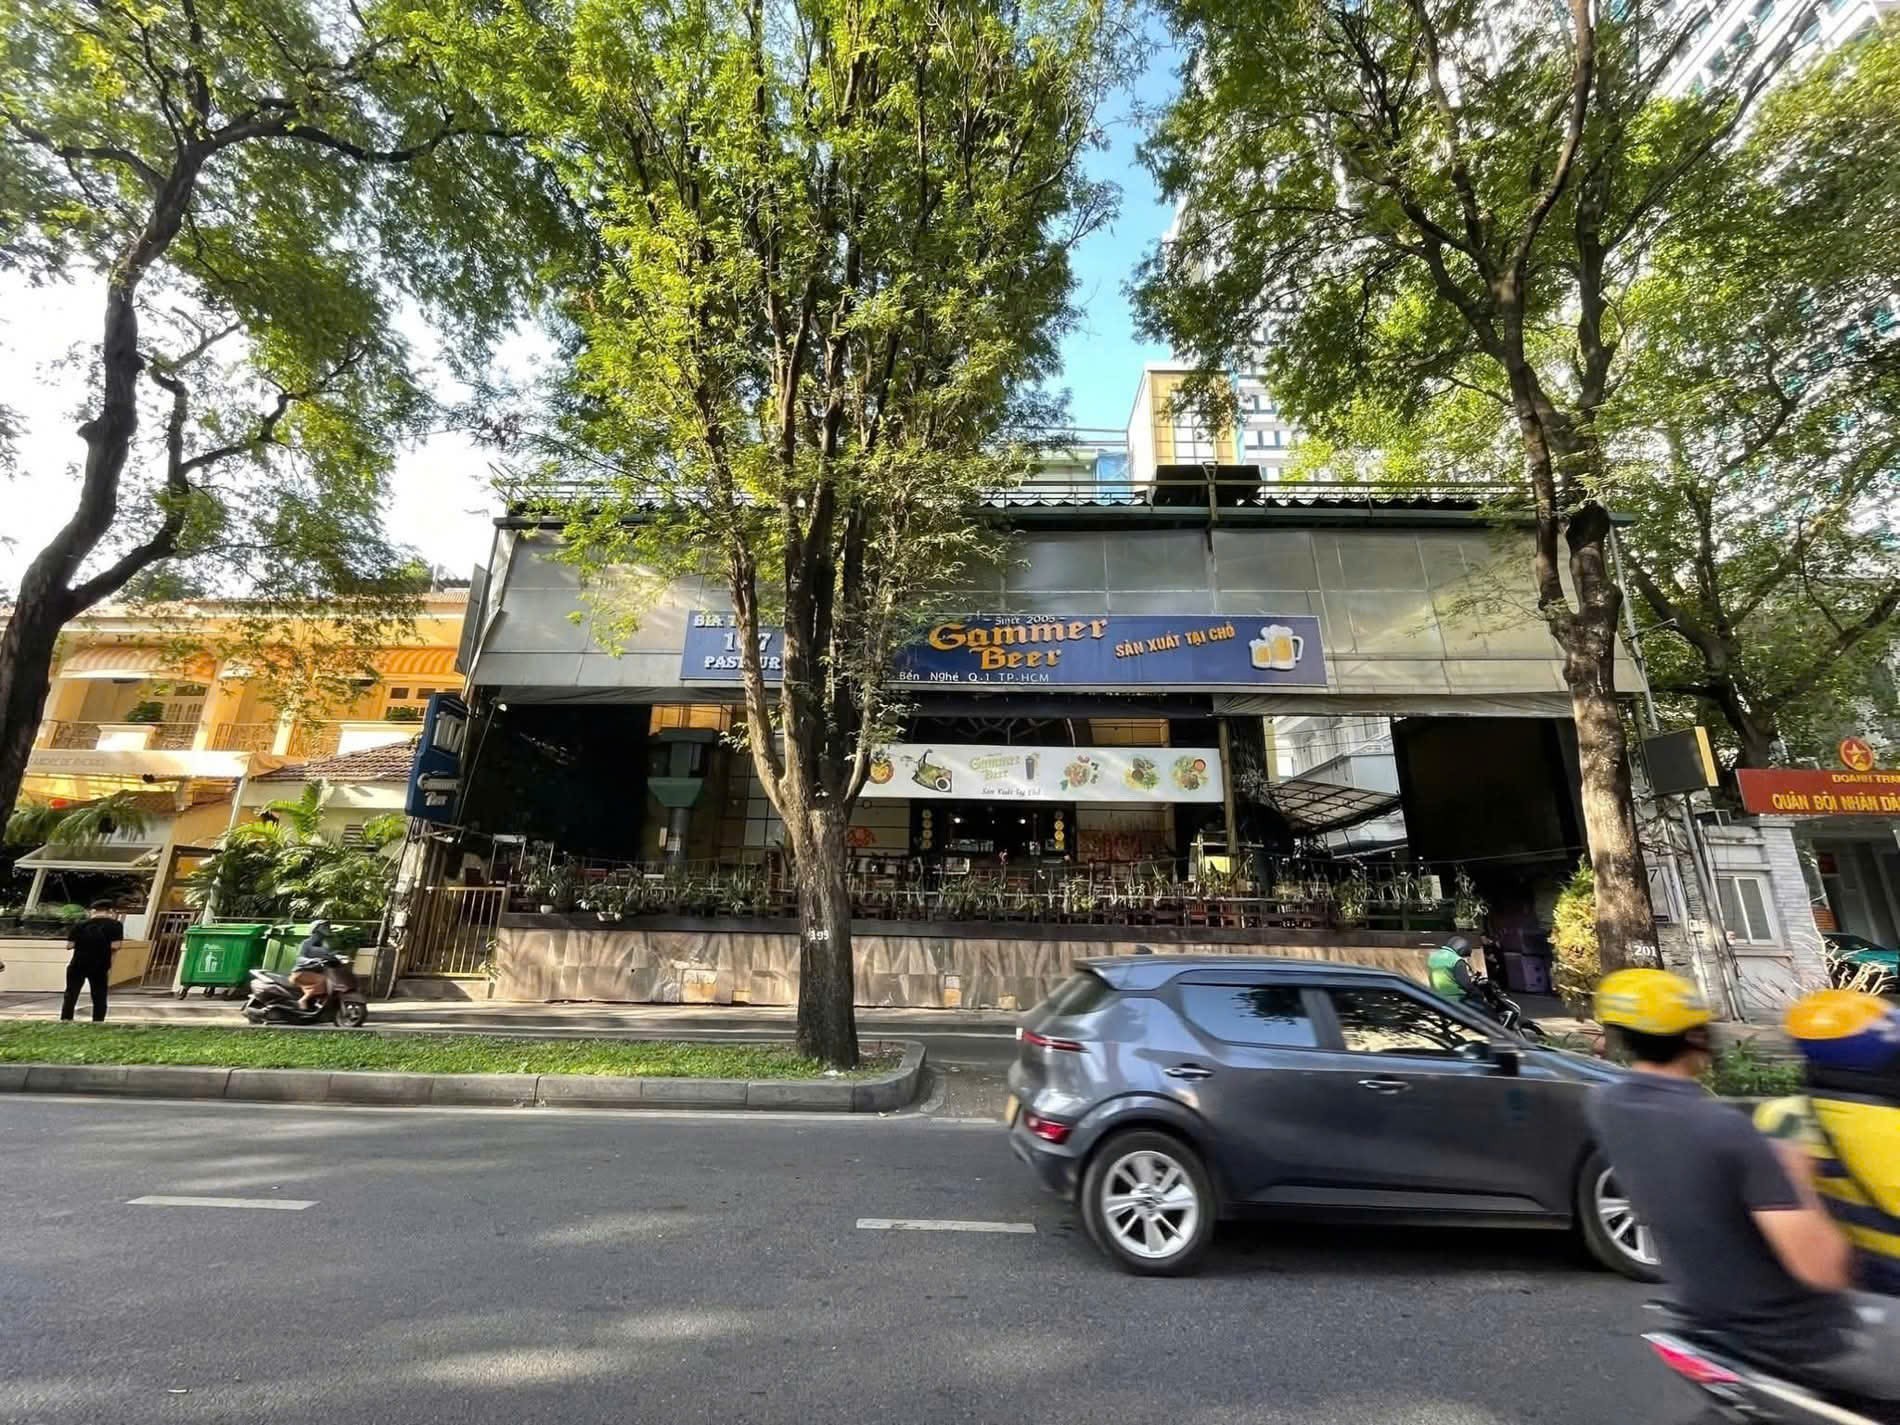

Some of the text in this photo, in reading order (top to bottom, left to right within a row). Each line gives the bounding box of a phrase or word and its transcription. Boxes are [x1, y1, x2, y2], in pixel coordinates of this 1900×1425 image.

[995, 615, 1056, 625] Since 2005
[724, 632, 772, 651] 17
[928, 617, 1109, 651] Gammer
[1184, 629, 1207, 646] TẠI
[704, 655, 782, 669] PASTUR
[969, 647, 1061, 671] Beer
[930, 671, 959, 682] Nghé
[968, 672, 990, 682] Q.1
[999, 672, 1049, 683] TP.HCM
[1831, 774, 1873, 784] DOANH
[1771, 791, 1810, 811] QUÂN
[1840, 792, 1880, 811] NHÂN
[1633, 945, 1657, 957] 201
